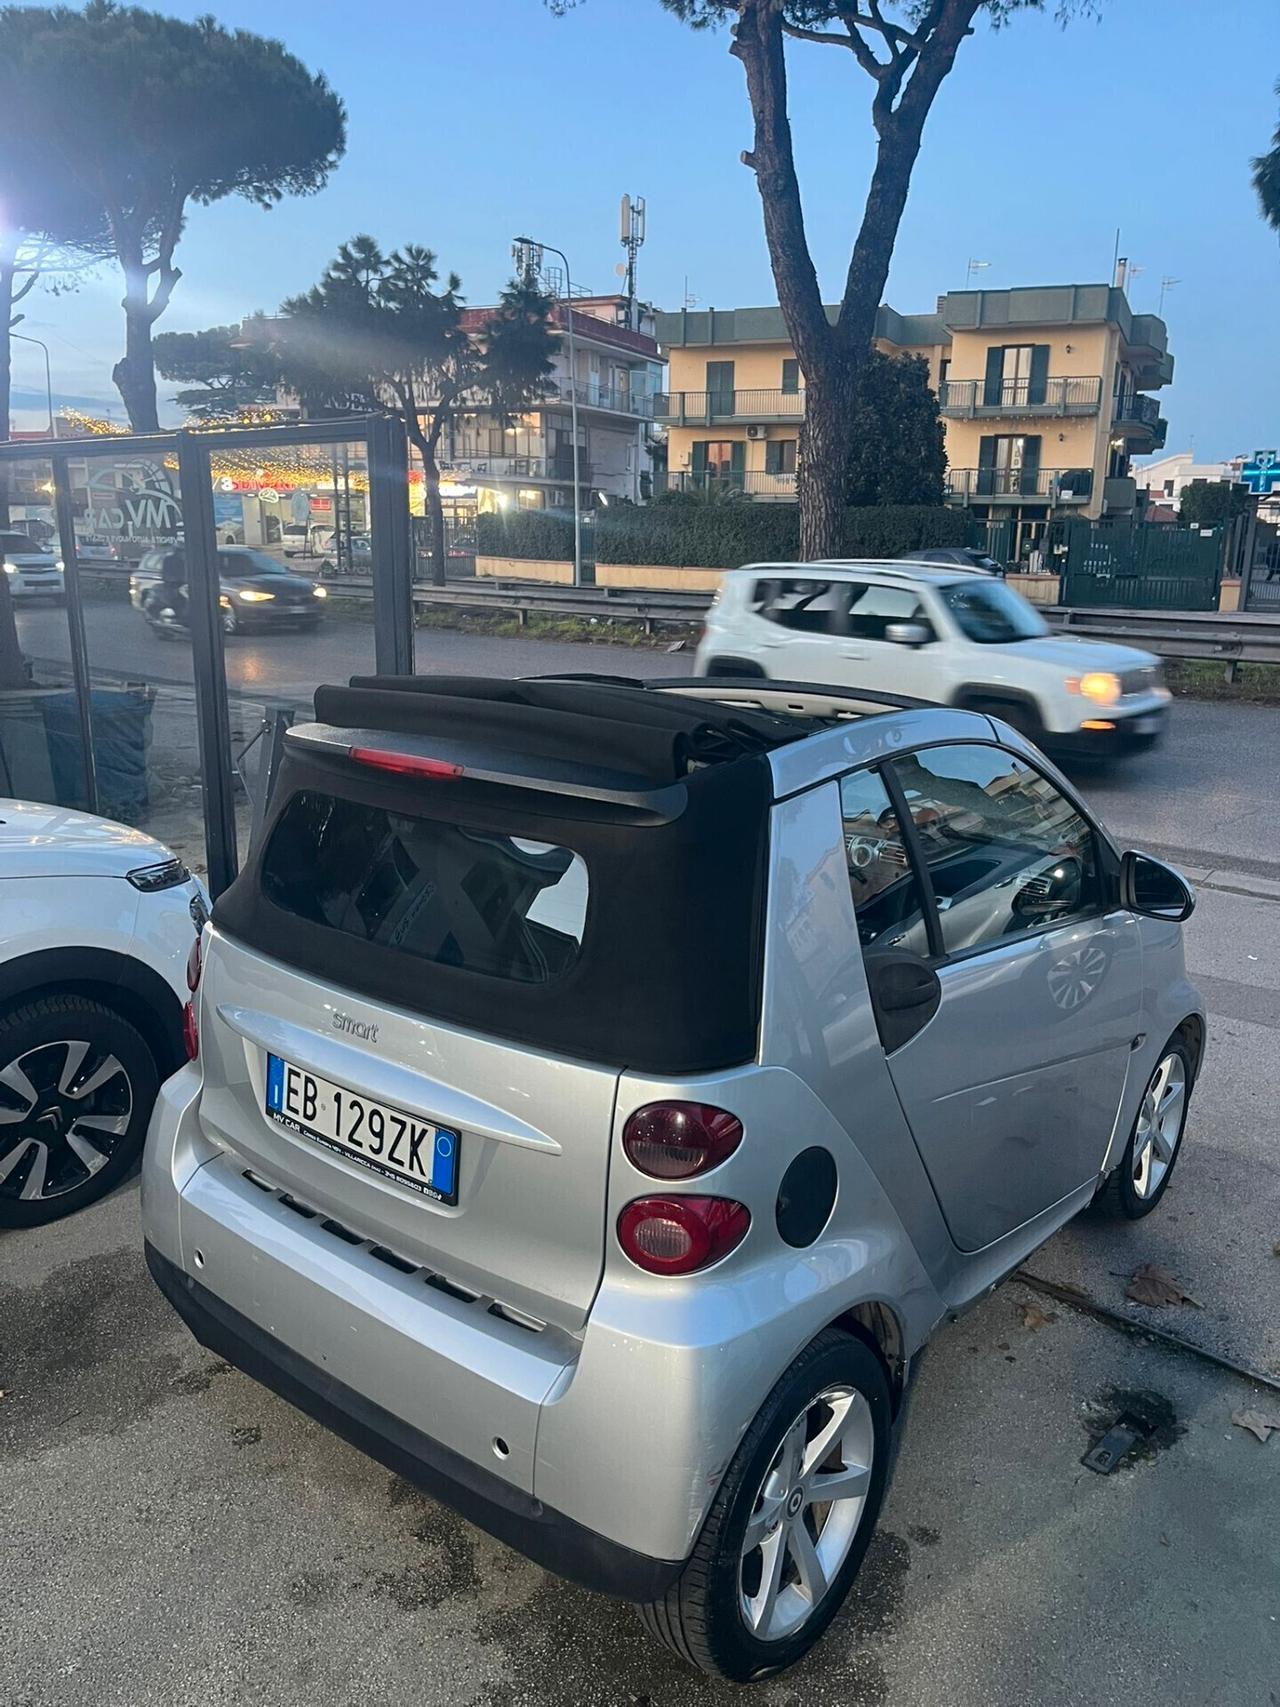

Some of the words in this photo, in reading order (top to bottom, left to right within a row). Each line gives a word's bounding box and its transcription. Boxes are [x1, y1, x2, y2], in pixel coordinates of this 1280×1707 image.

[333, 1013, 379, 1043] smart
[273, 1112, 285, 1124] MV
[285, 1119, 301, 1132] CAR
[286, 1067, 318, 1122] EB
[333, 1091, 429, 1177] 129ZK
